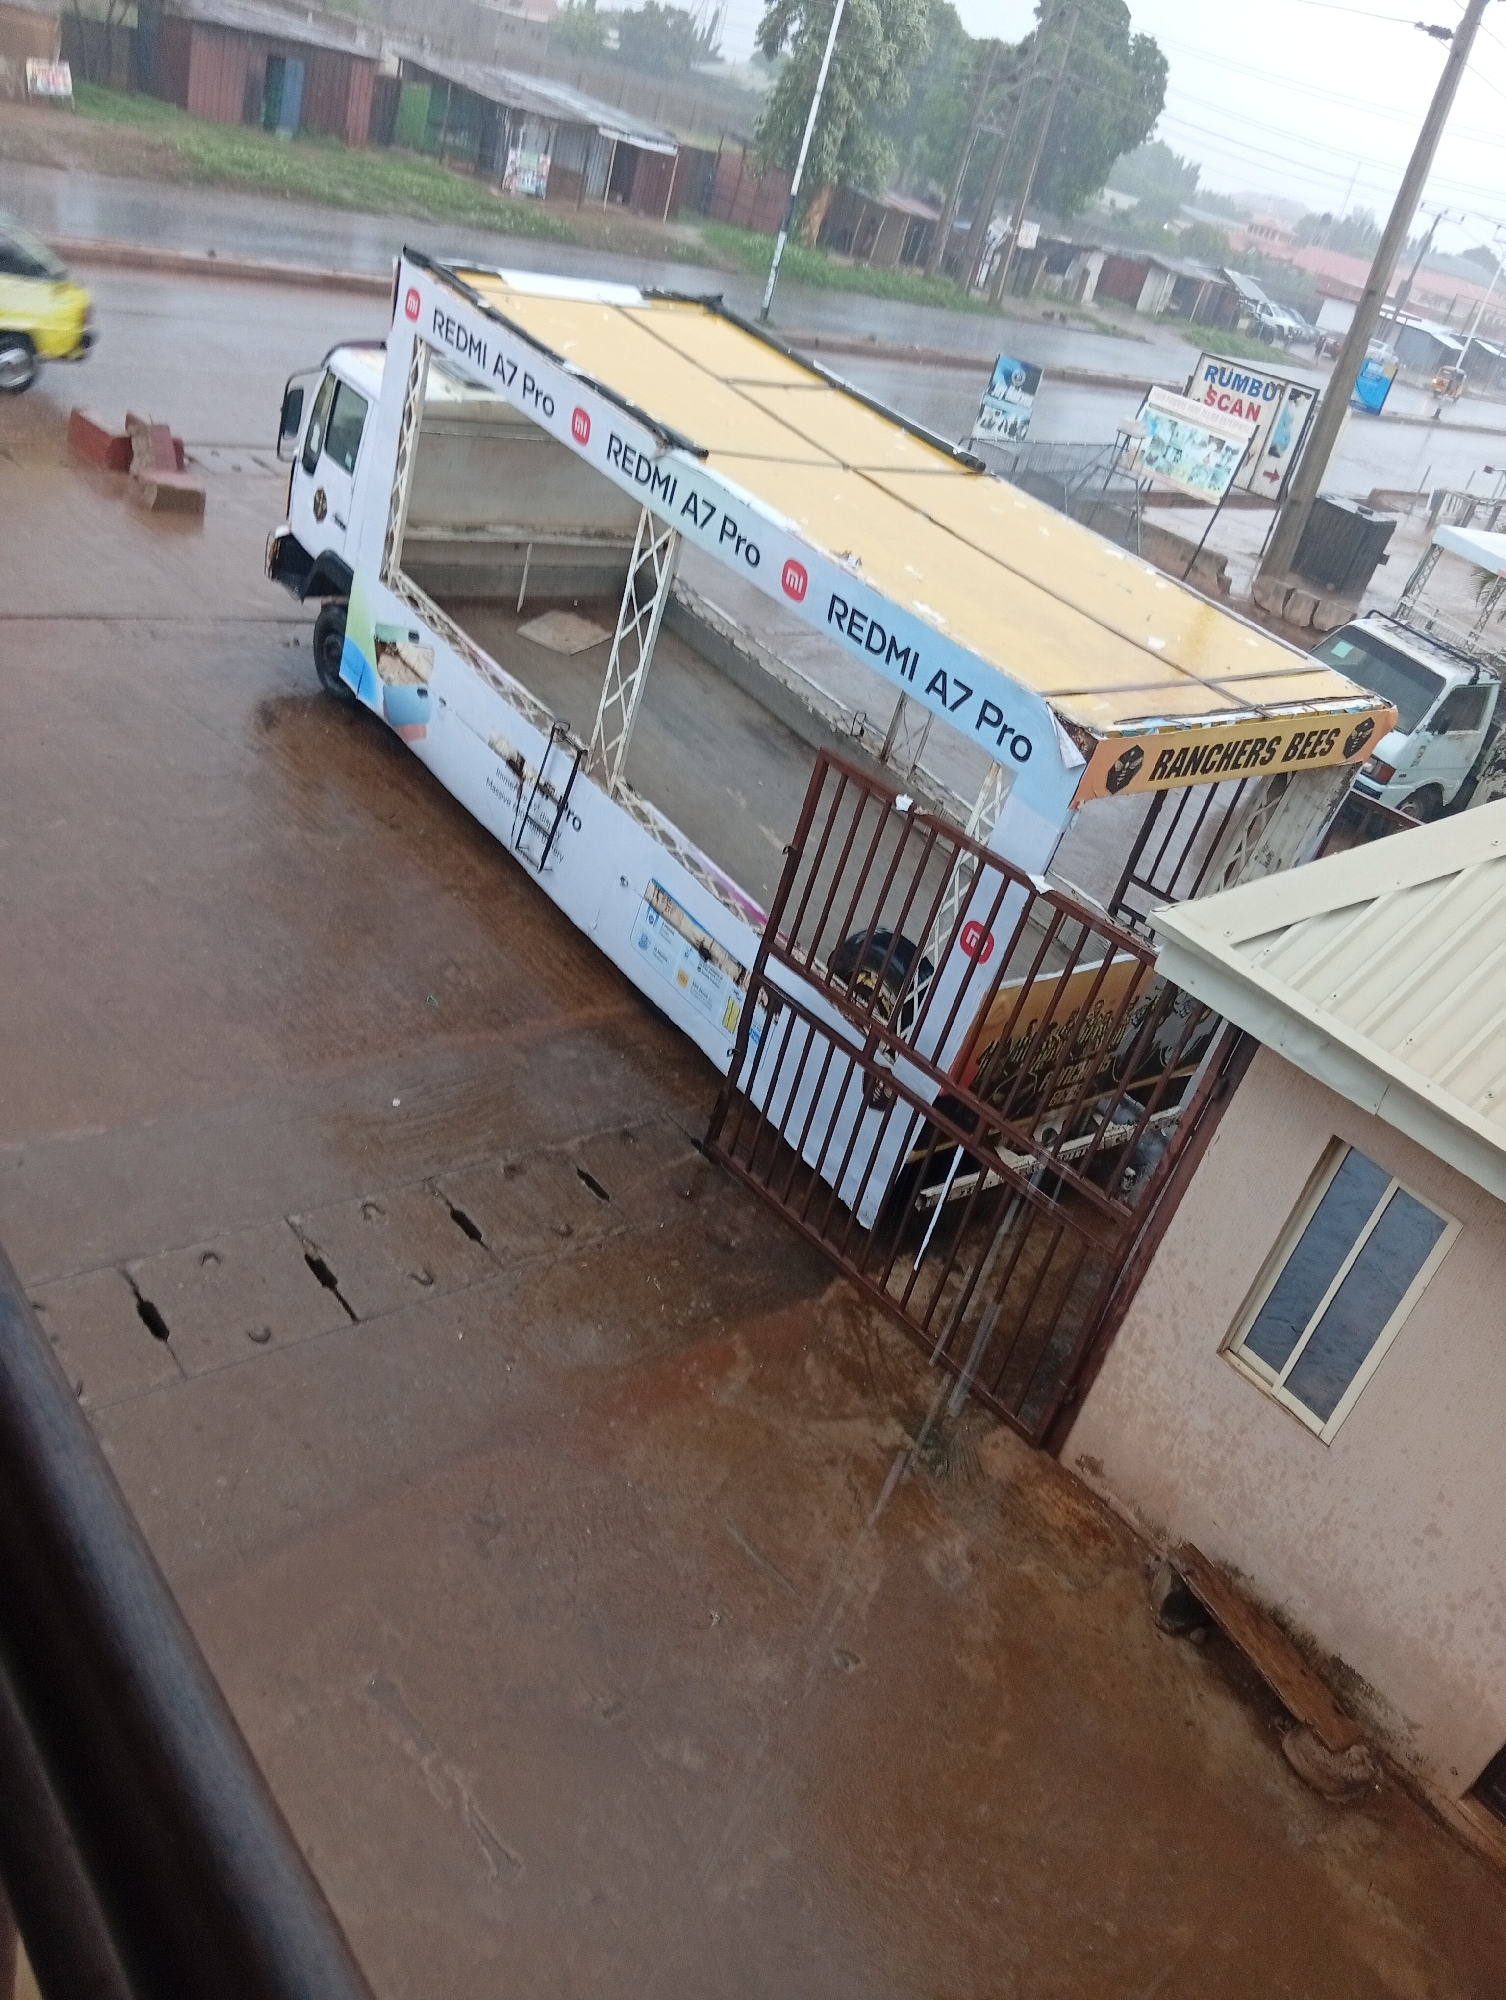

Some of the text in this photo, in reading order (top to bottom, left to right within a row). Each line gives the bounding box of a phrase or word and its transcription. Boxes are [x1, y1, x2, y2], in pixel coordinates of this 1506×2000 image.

[432, 308, 555, 418] REDMI A7 Pro
[1203, 364, 1278, 402] RUMBU
[1203, 389, 1261, 422] SCAN
[606, 433, 761, 568] REDMI A7 Pro
[827, 592, 1033, 763] REDMI A7 Pro
[1148, 727, 1342, 782] RANCHERS BEES
